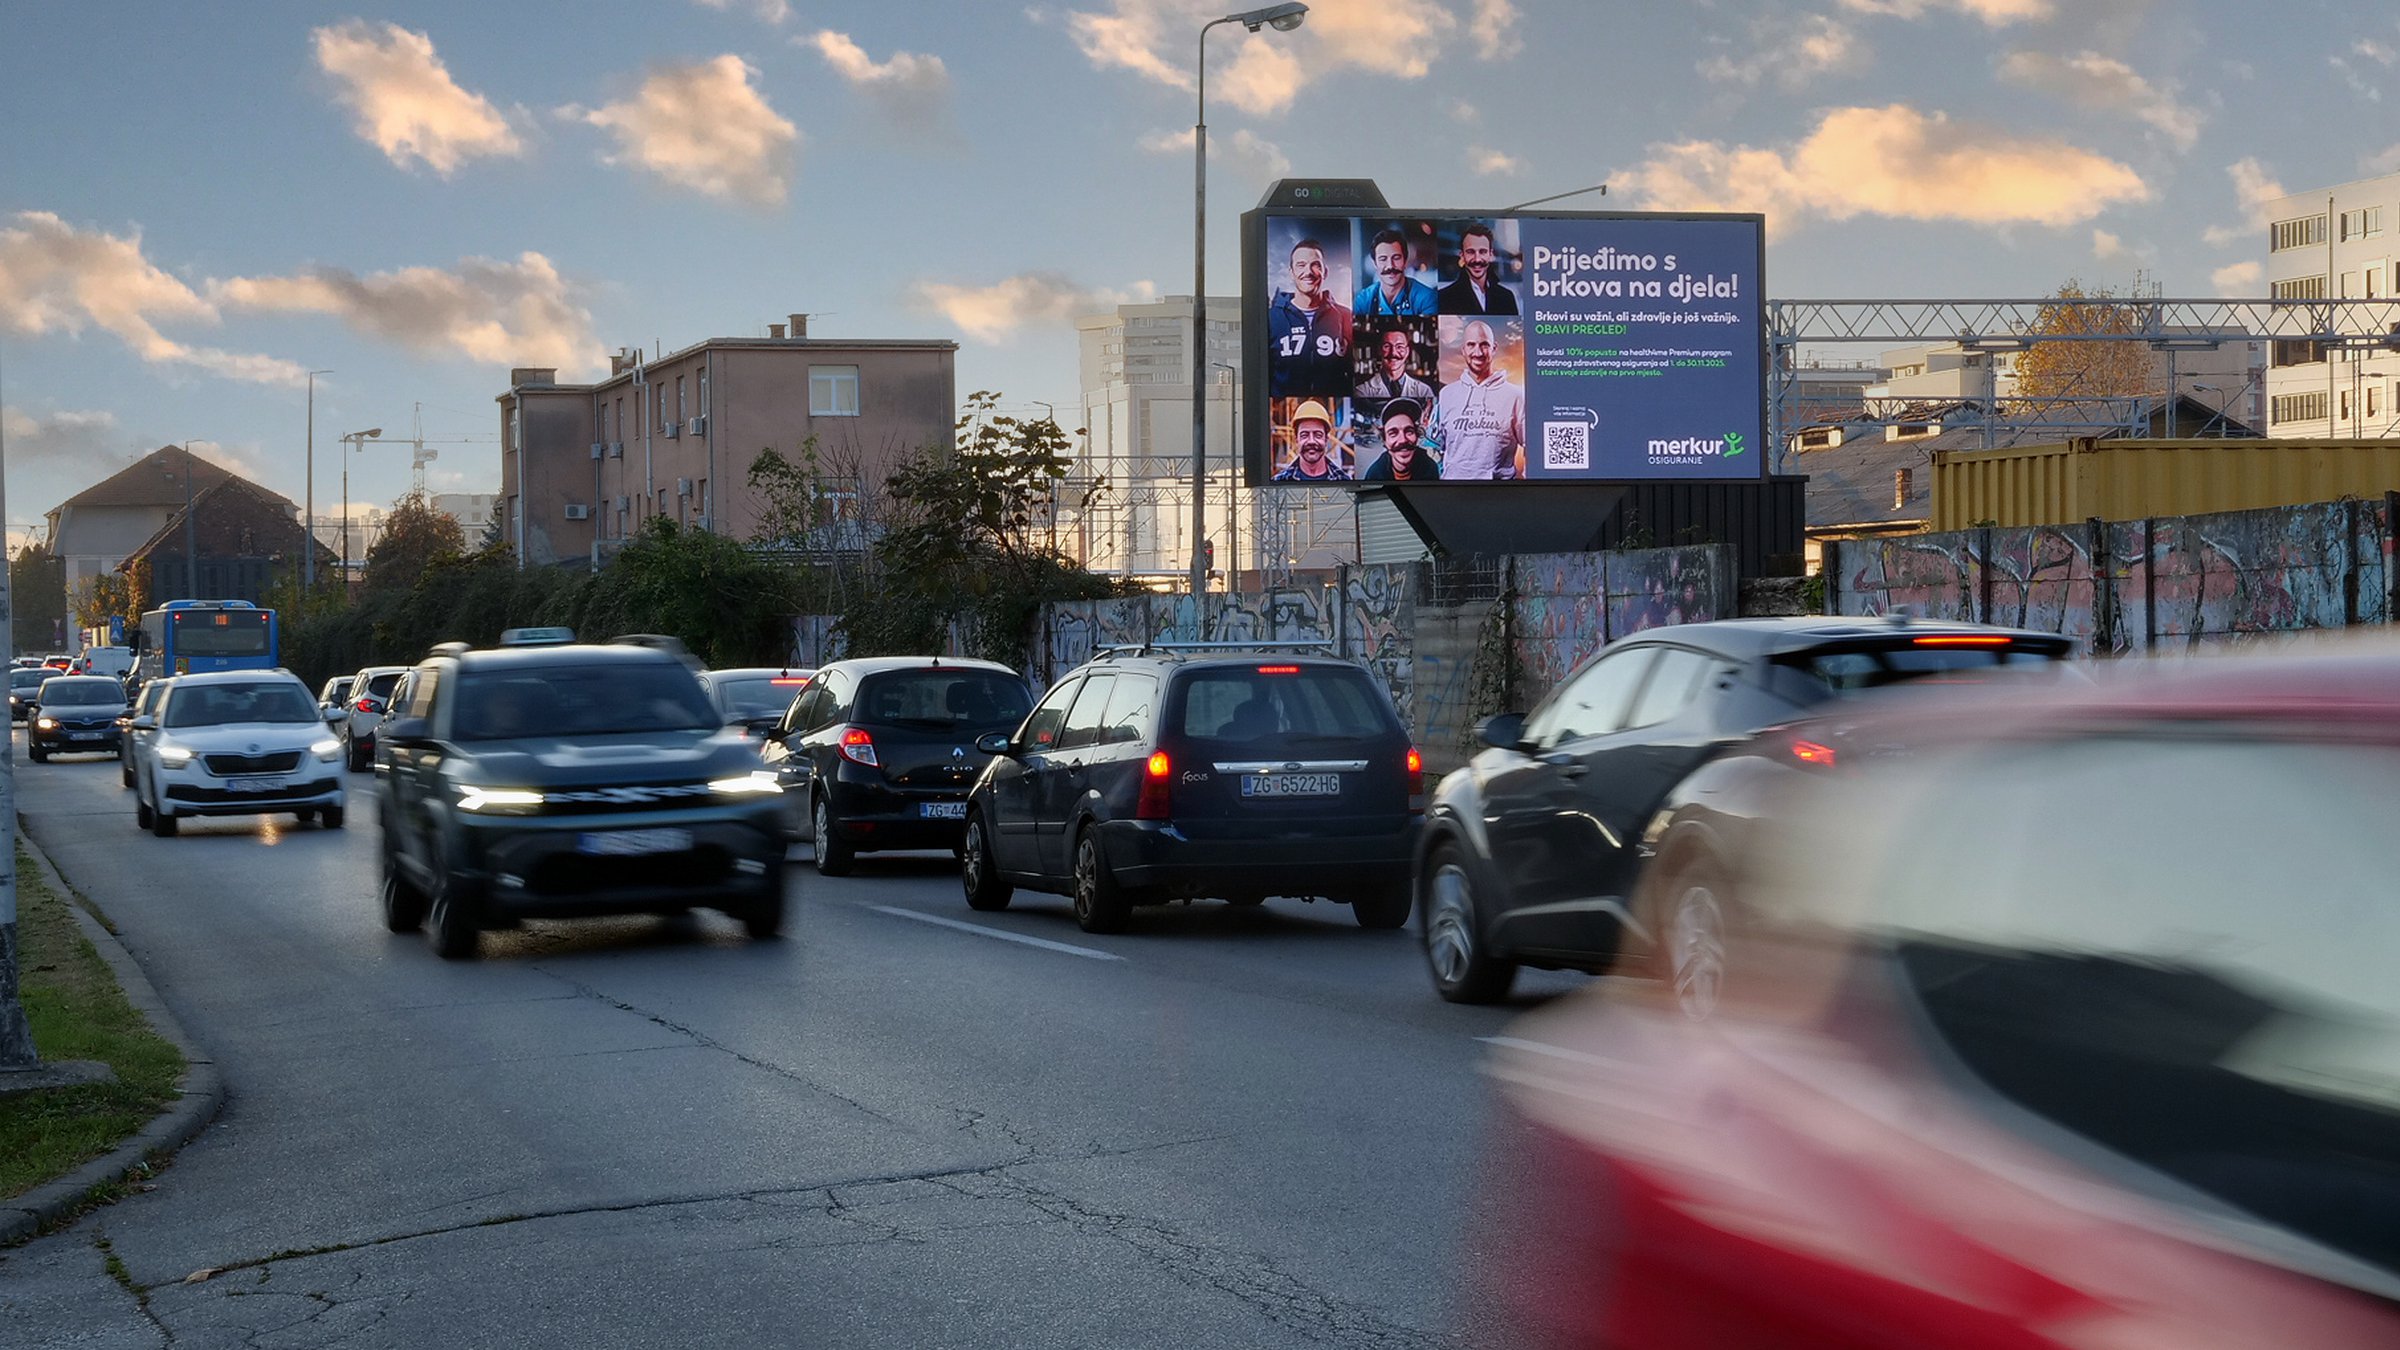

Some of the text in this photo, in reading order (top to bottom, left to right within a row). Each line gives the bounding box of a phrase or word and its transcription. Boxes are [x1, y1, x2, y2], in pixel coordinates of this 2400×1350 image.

[1294, 187, 1310, 198] GO
[1533, 246, 1677, 276] Prijeđimo s
[1533, 273, 1739, 304] brkova na djela!
[1535, 310, 1740, 325] Brkovi su važni, ali zdravlje je još važnije.
[1535, 324, 1627, 335] OBAVI PREGLED!
[1279, 334, 1307, 357] 17
[1536, 348, 1565, 356] Iskoristi
[1566, 347, 1584, 356] 10%
[1584, 349, 1618, 357] popusta
[1668, 348, 1701, 356] Premium
[1701, 349, 1733, 358] program
[1536, 359, 1572, 368] dodatnog
[1573, 359, 1620, 368] zdravstvenog
[1621, 359, 1658, 368] osiguranja
[1659, 359, 1669, 367] od
[1560, 369, 1579, 377] svoje
[1580, 369, 1608, 377] zdravlje
[1453, 417, 1501, 432] Merkur
[1647, 436, 1724, 455] merkur
[1647, 456, 1703, 465] OSIGURANJE
[1181, 770, 1209, 785] Focus
[1252, 777, 1272, 793] ZG
[928, 804, 943, 817] ZG
